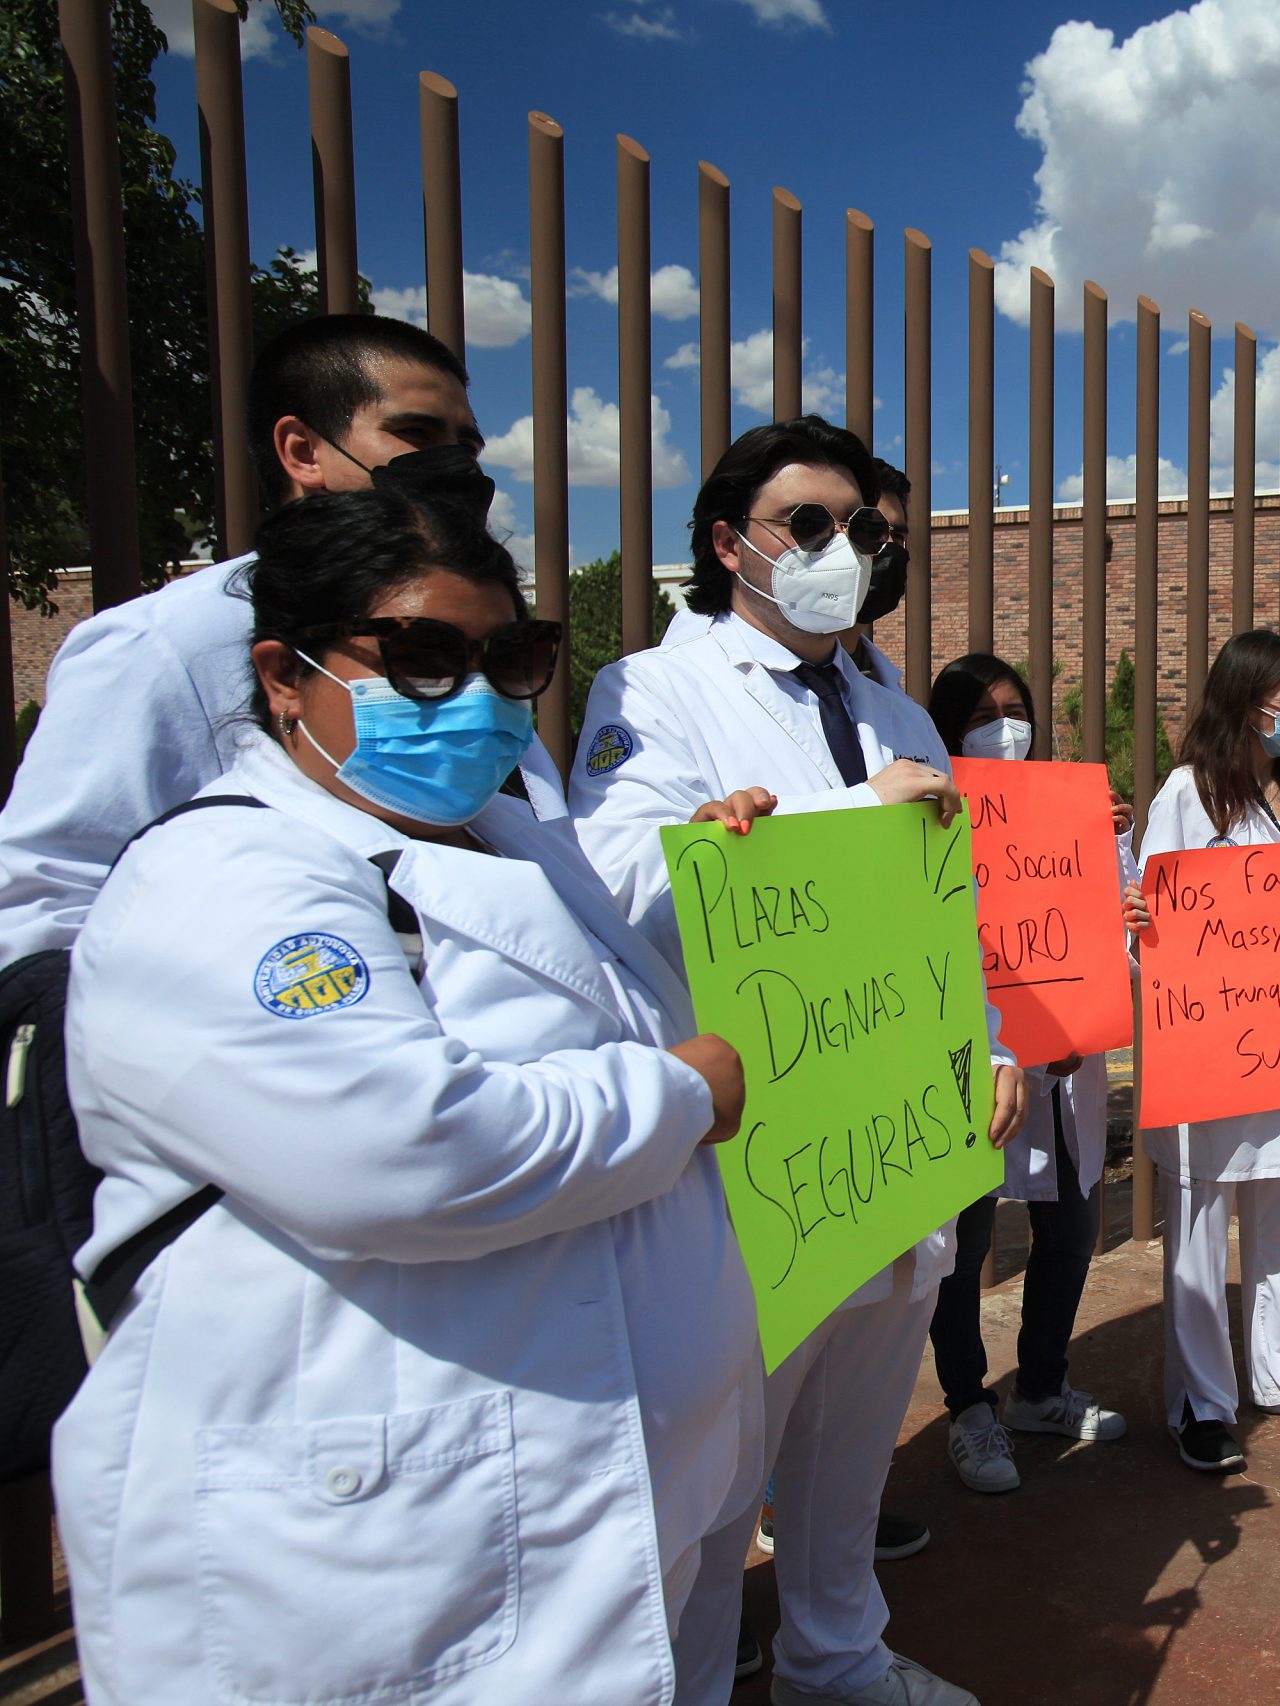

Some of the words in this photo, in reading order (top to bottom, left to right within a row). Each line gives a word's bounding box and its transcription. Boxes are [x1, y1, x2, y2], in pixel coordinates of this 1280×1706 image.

[1005, 839, 1082, 882] Social
[1156, 859, 1215, 917] Nos
[676, 838, 830, 963] PLAZAS
[978, 907, 1068, 971] GURO
[736, 969, 906, 1084] DIGNAS
[926, 952, 950, 1021] Y
